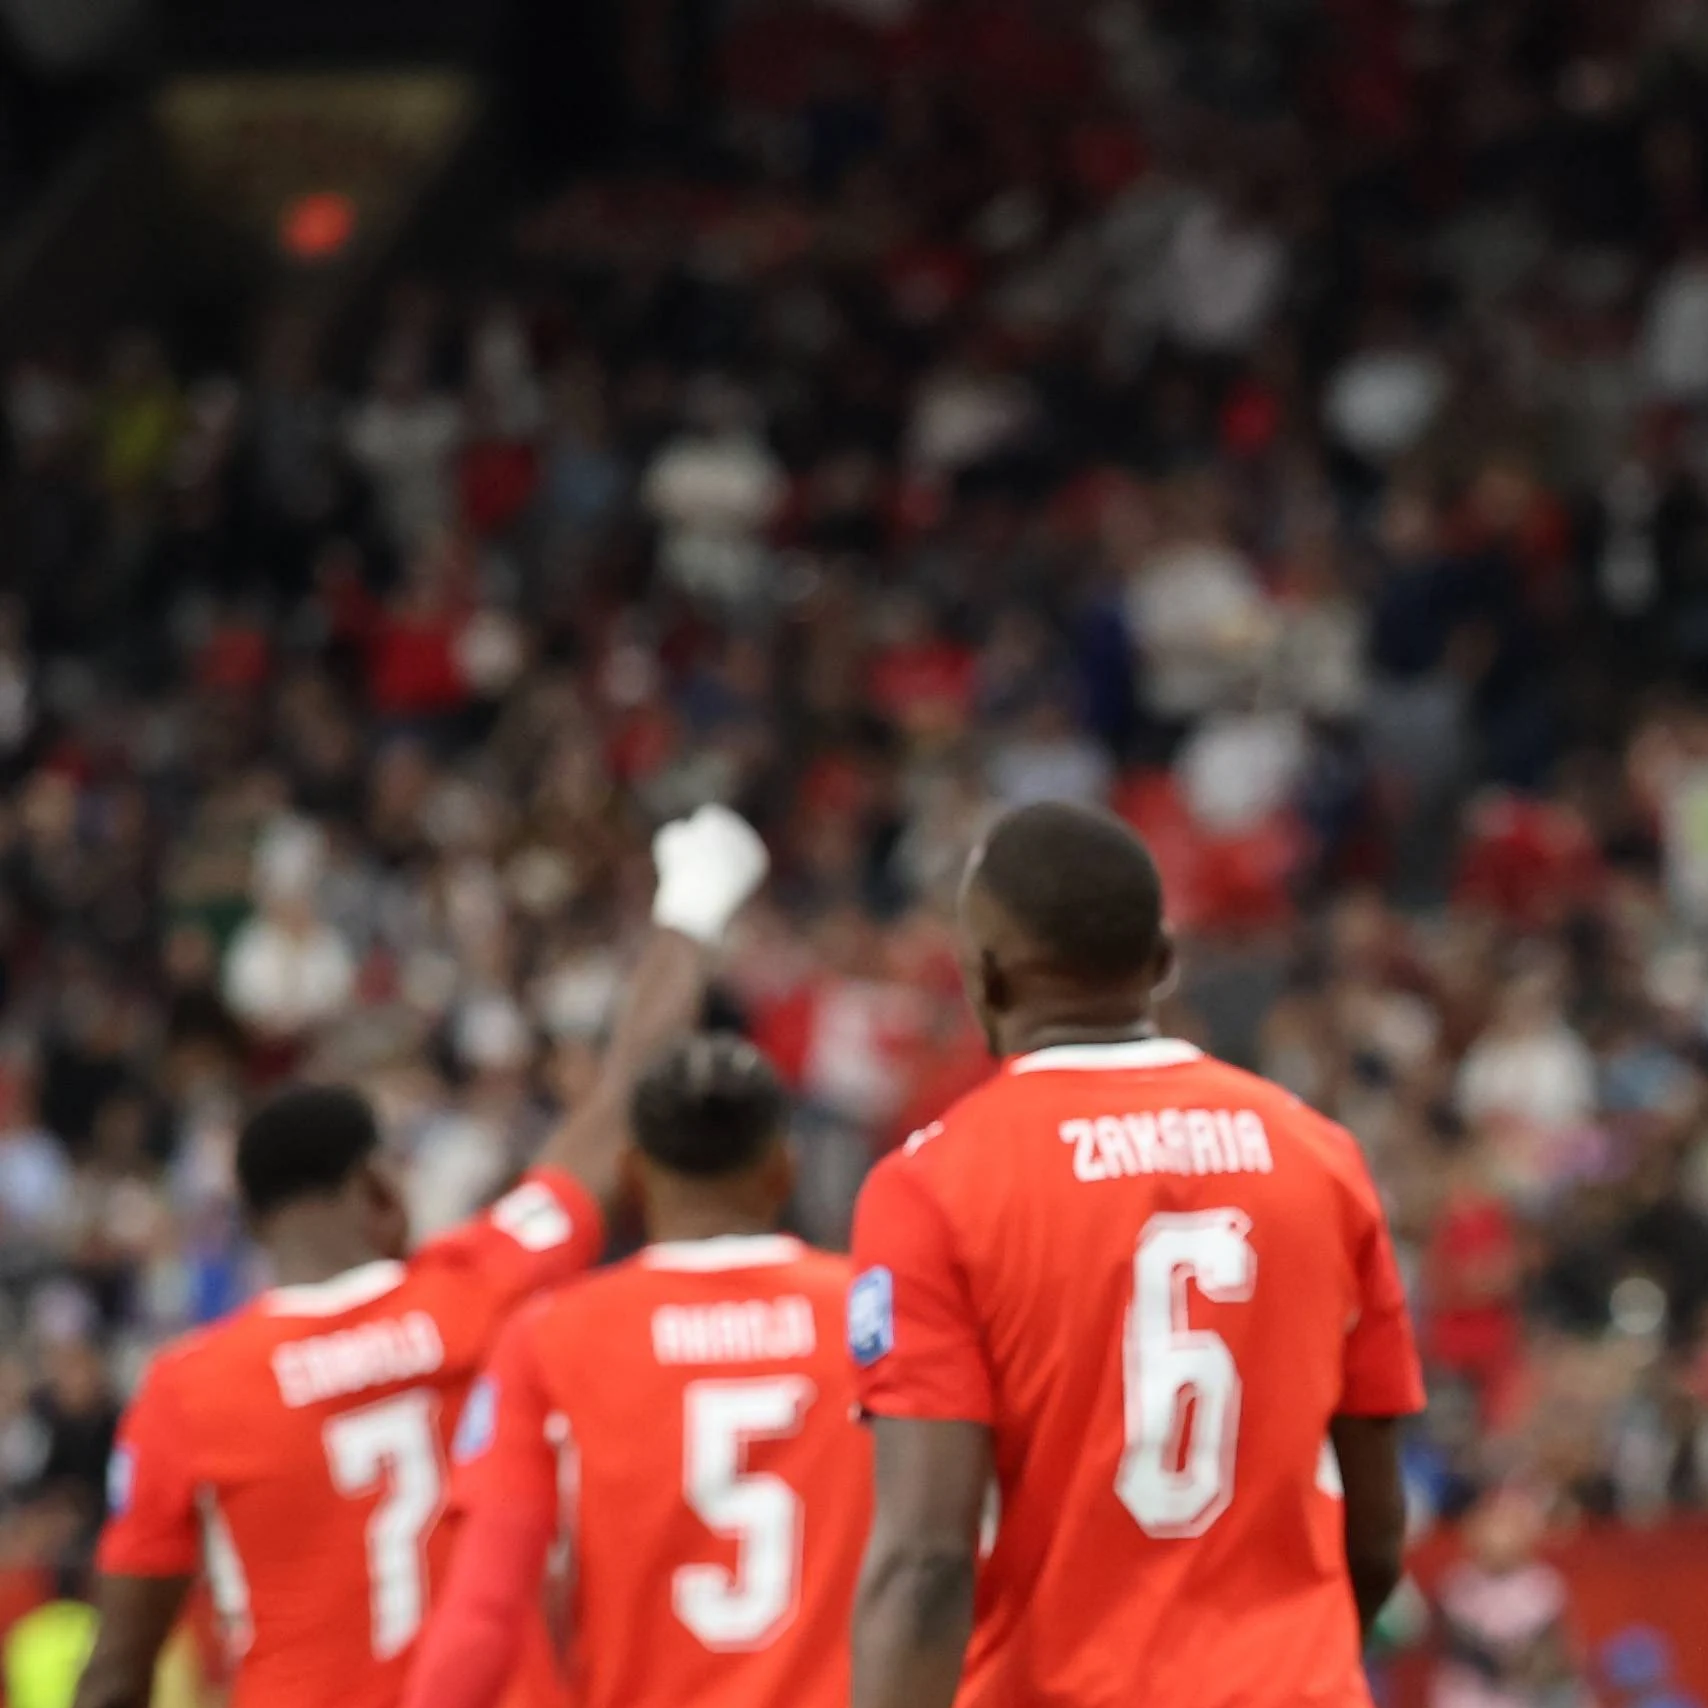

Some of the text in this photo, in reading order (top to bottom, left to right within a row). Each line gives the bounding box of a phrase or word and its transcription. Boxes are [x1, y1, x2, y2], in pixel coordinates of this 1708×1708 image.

[1058, 1107, 1274, 1183] ZAKARIA
[1114, 1206, 1258, 1540] 6
[322, 1386, 446, 1663] 7
[671, 1375, 818, 1654] 5
